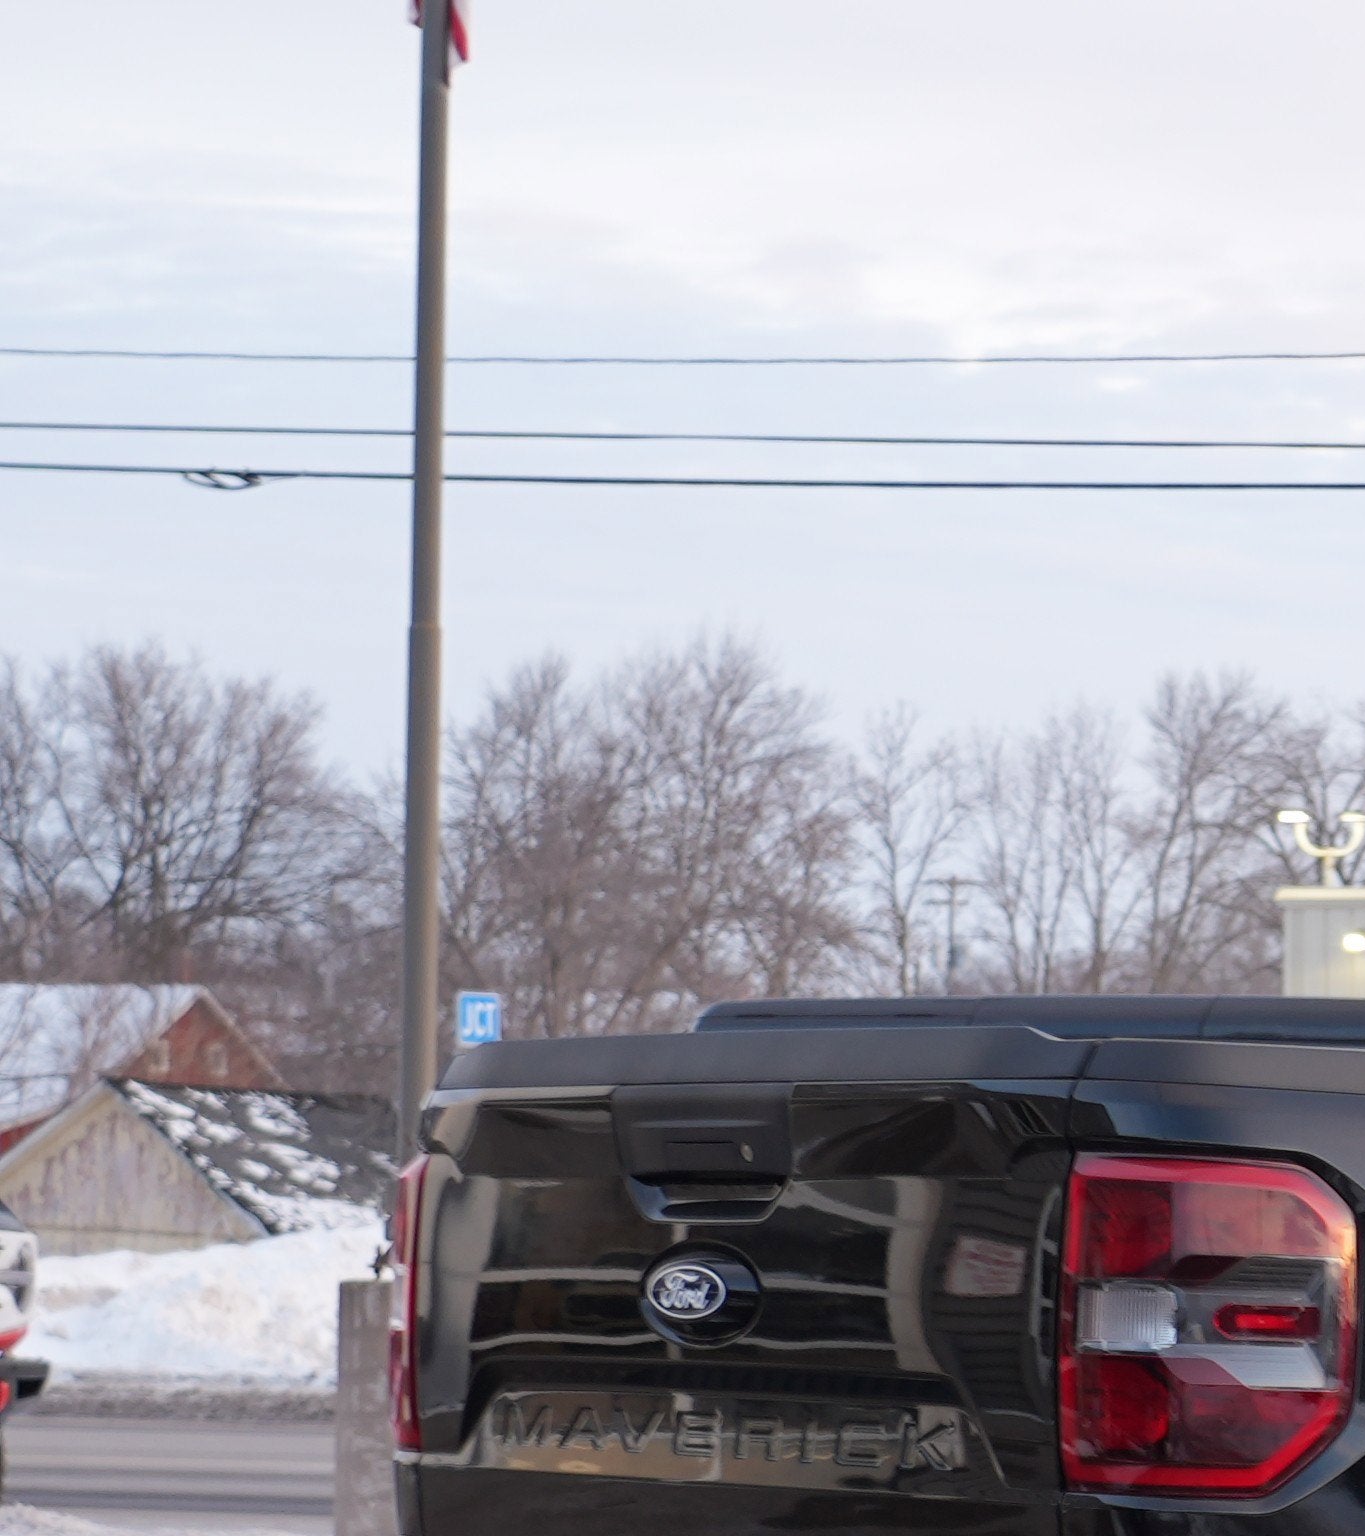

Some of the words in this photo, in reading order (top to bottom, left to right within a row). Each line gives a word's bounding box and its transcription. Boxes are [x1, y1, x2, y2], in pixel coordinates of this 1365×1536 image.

[462, 1002, 497, 1037] JCT
[657, 1270, 713, 1310] Ford
[500, 1401, 958, 1472] MAVERICK
